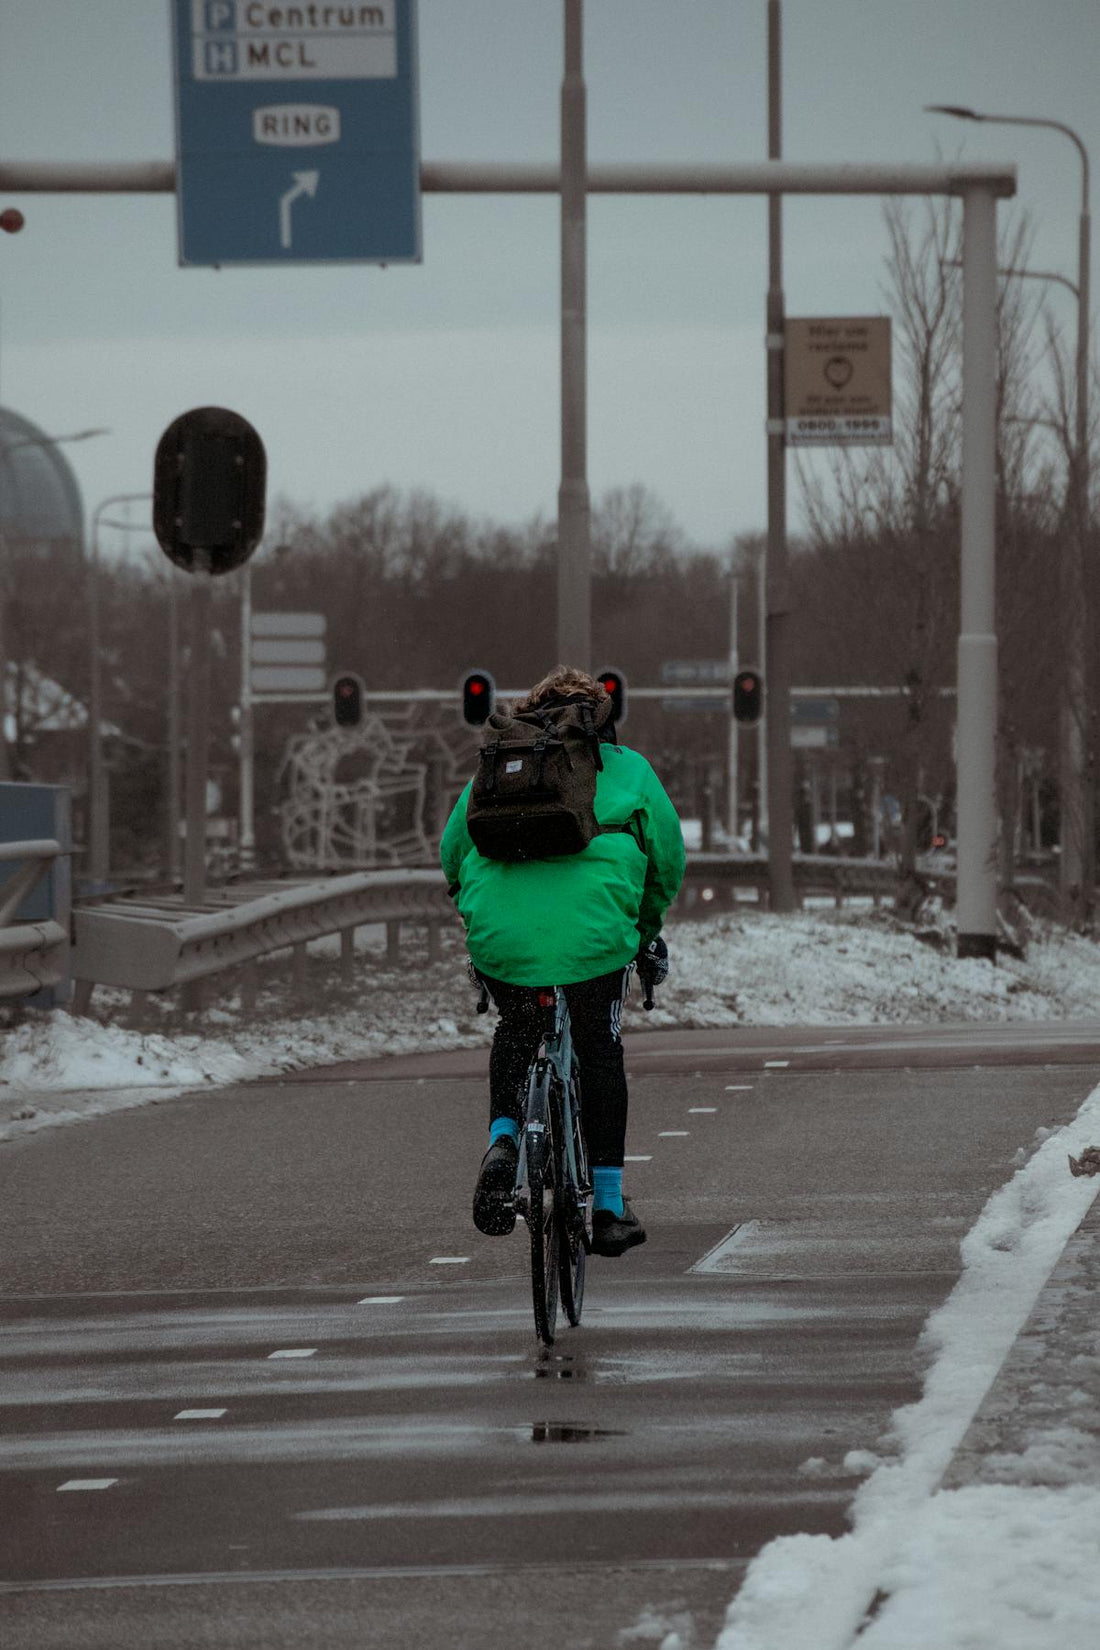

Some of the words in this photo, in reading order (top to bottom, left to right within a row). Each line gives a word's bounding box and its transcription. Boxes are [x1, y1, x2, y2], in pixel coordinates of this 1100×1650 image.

[246, 3, 384, 28] Centrum
[247, 42, 316, 68] MCL
[262, 114, 331, 136] RING
